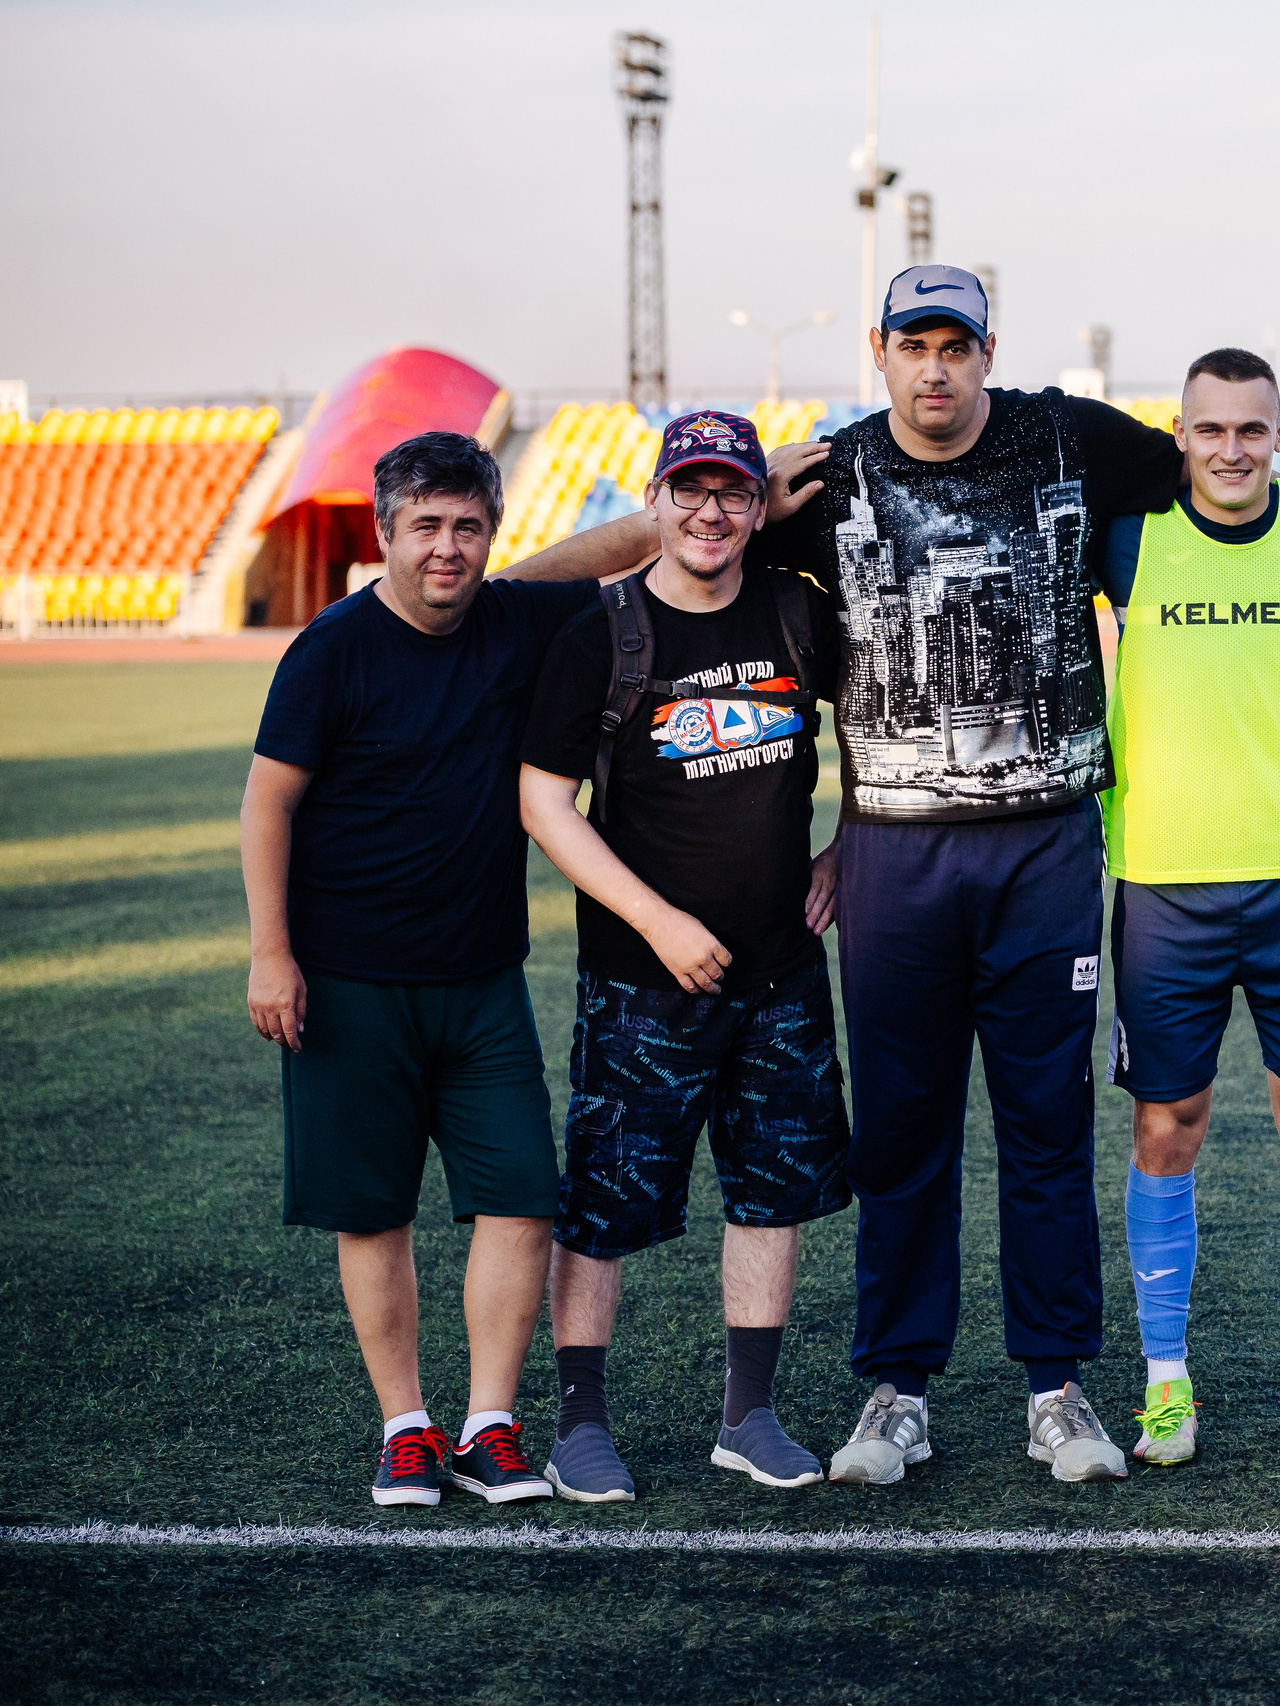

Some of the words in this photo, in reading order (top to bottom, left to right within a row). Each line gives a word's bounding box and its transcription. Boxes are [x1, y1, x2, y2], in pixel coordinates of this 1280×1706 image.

[1161, 602, 1280, 626] KELME
[676, 662, 733, 688] ЖНЫЙ
[735, 661, 775, 683] УРАЛ
[682, 738, 794, 780] МАГНИТОГОРСК
[740, 1089, 768, 1103] sailing
[745, 1163, 764, 1177] across
[745, 1201, 775, 1217] sailing
